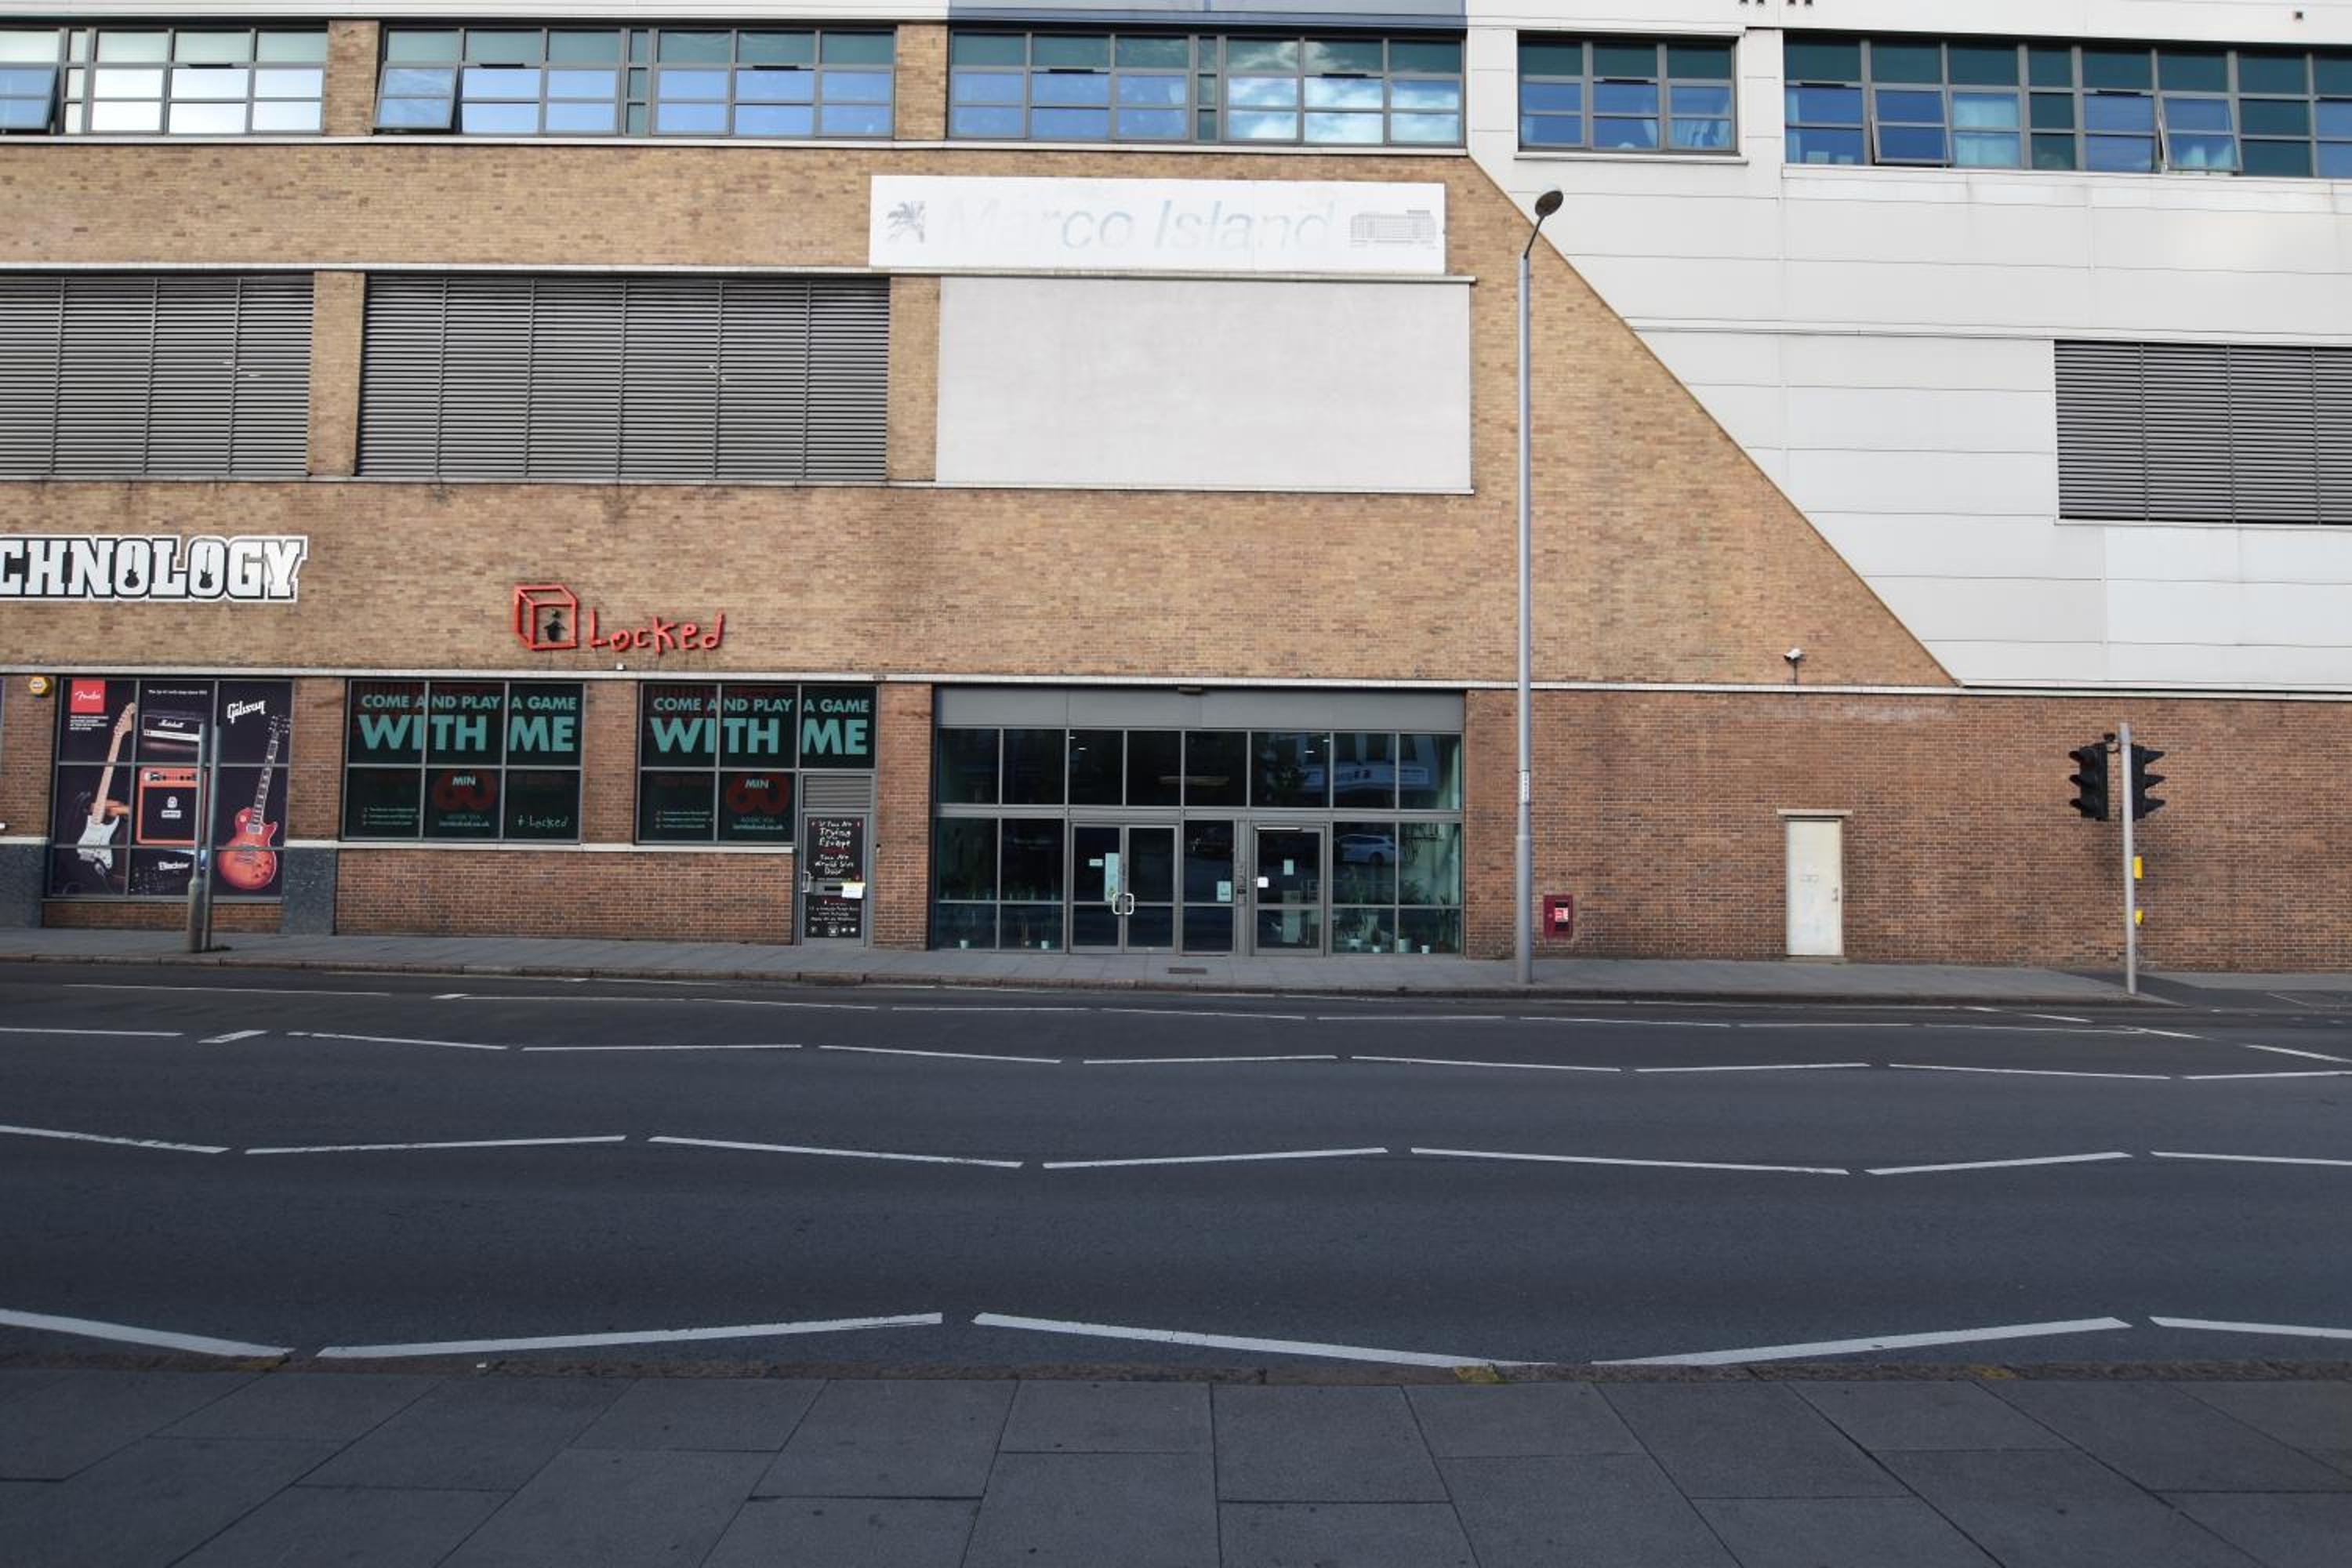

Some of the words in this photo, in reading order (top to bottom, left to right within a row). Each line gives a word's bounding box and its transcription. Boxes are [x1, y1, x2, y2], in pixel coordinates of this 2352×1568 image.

[942, 196, 1134, 252] Marco
[1153, 198, 1337, 252] Island
[588, 607, 726, 654] Locked
[361, 695, 410, 708] COME
[414, 695, 456, 709] AND
[462, 695, 502, 709] PLAY
[510, 696, 523, 709] A
[527, 696, 577, 711] GAME
[653, 697, 701, 711] COME
[707, 698, 749, 712] AND
[753, 698, 792, 712] PLAY
[803, 699, 815, 712] A
[820, 699, 869, 713] GAME
[227, 700, 267, 724] Gibson
[358, 714, 488, 751] WITH
[509, 715, 575, 752] ME
[649, 717, 779, 753] WITH
[801, 718, 868, 755] ME
[452, 775, 477, 786] MIN
[744, 779, 769, 789] MIN
[819, 827, 851, 840] Trying
[818, 837, 851, 849] Escape
